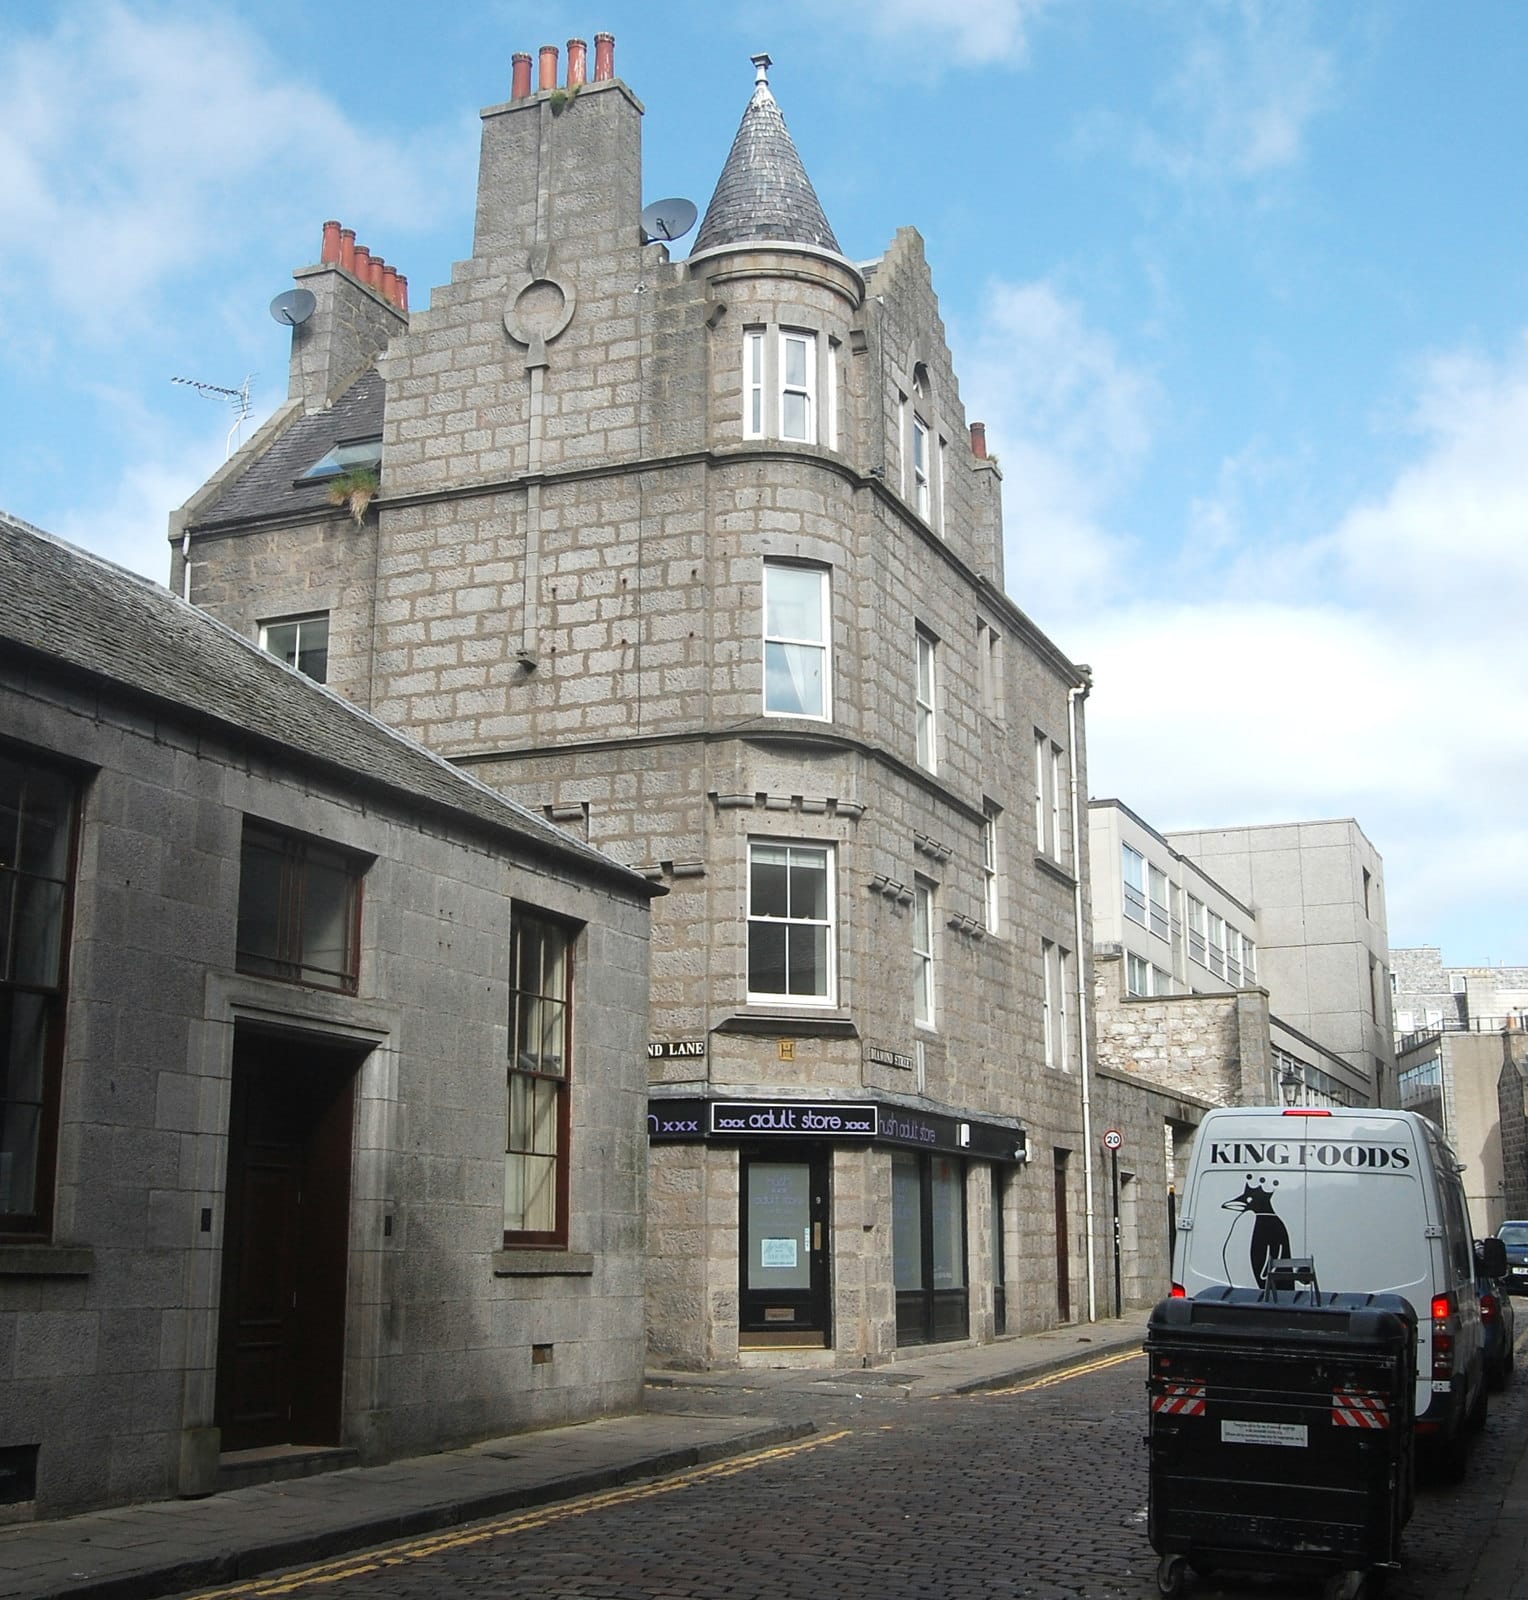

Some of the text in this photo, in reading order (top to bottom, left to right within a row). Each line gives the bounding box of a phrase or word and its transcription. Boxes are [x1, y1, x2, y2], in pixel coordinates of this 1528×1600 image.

[669, 1042, 704, 1056] LANE
[663, 1120, 699, 1132] xxx
[719, 1108, 871, 1131] xxx adult store xxx
[899, 1119, 918, 1140] adult
[919, 1121, 936, 1143] store
[1106, 1134, 1120, 1145] 20
[1211, 1143, 1411, 1169] KING FOODS
